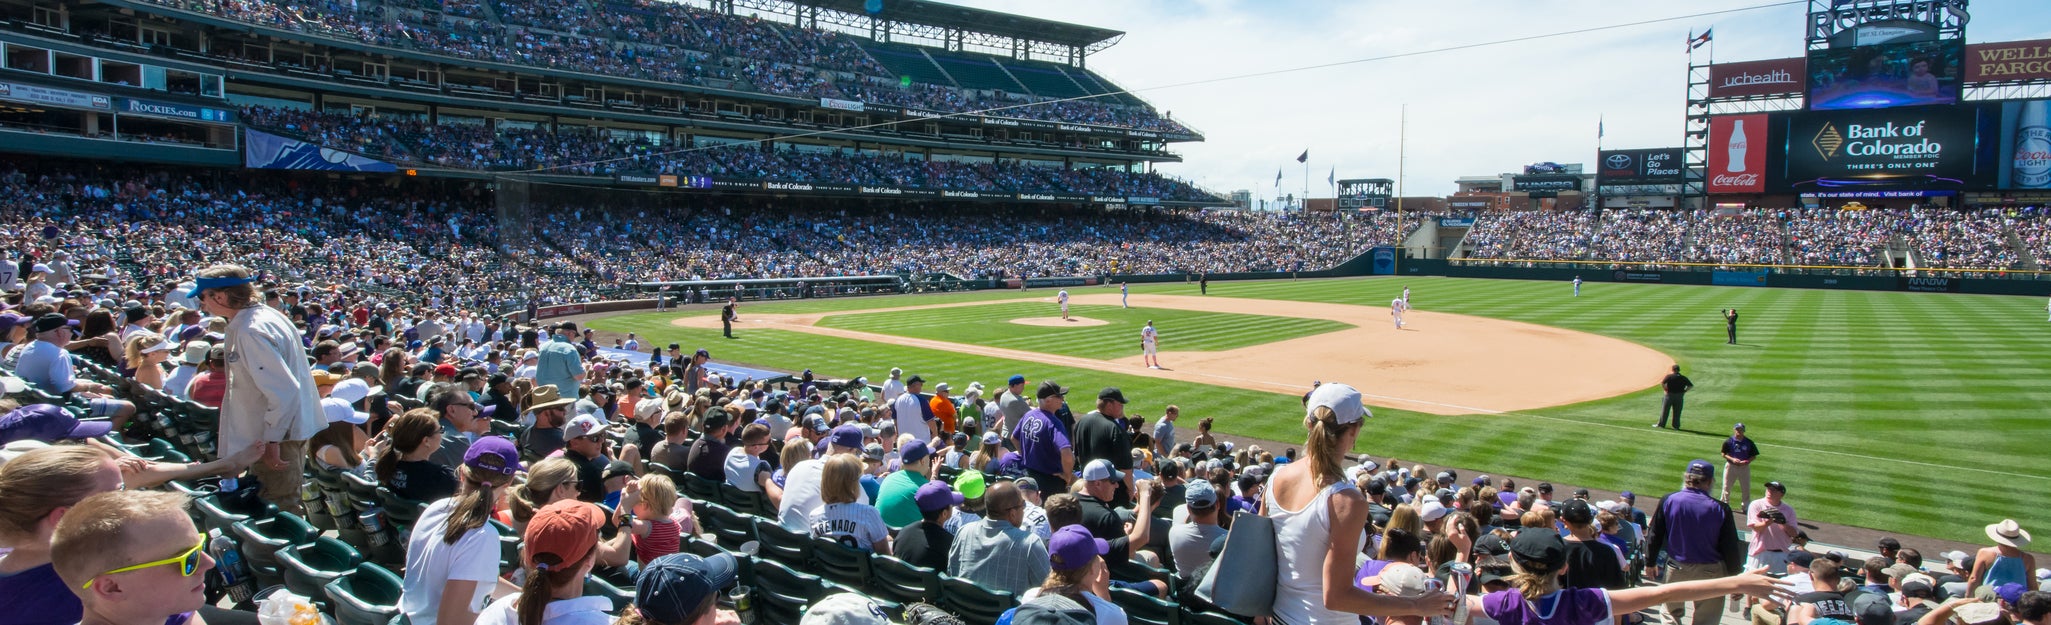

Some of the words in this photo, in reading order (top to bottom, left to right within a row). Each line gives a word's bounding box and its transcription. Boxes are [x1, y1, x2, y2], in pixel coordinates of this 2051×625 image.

[1725, 69, 1791, 86] uchealth
[923, 111, 940, 119] Colorado
[1848, 122, 1900, 138] Bank
[1902, 120, 1925, 137] of
[1846, 138, 1941, 156] Colorado
[1713, 174, 1759, 186] Coca-Cola
[1022, 416, 1043, 442] 42
